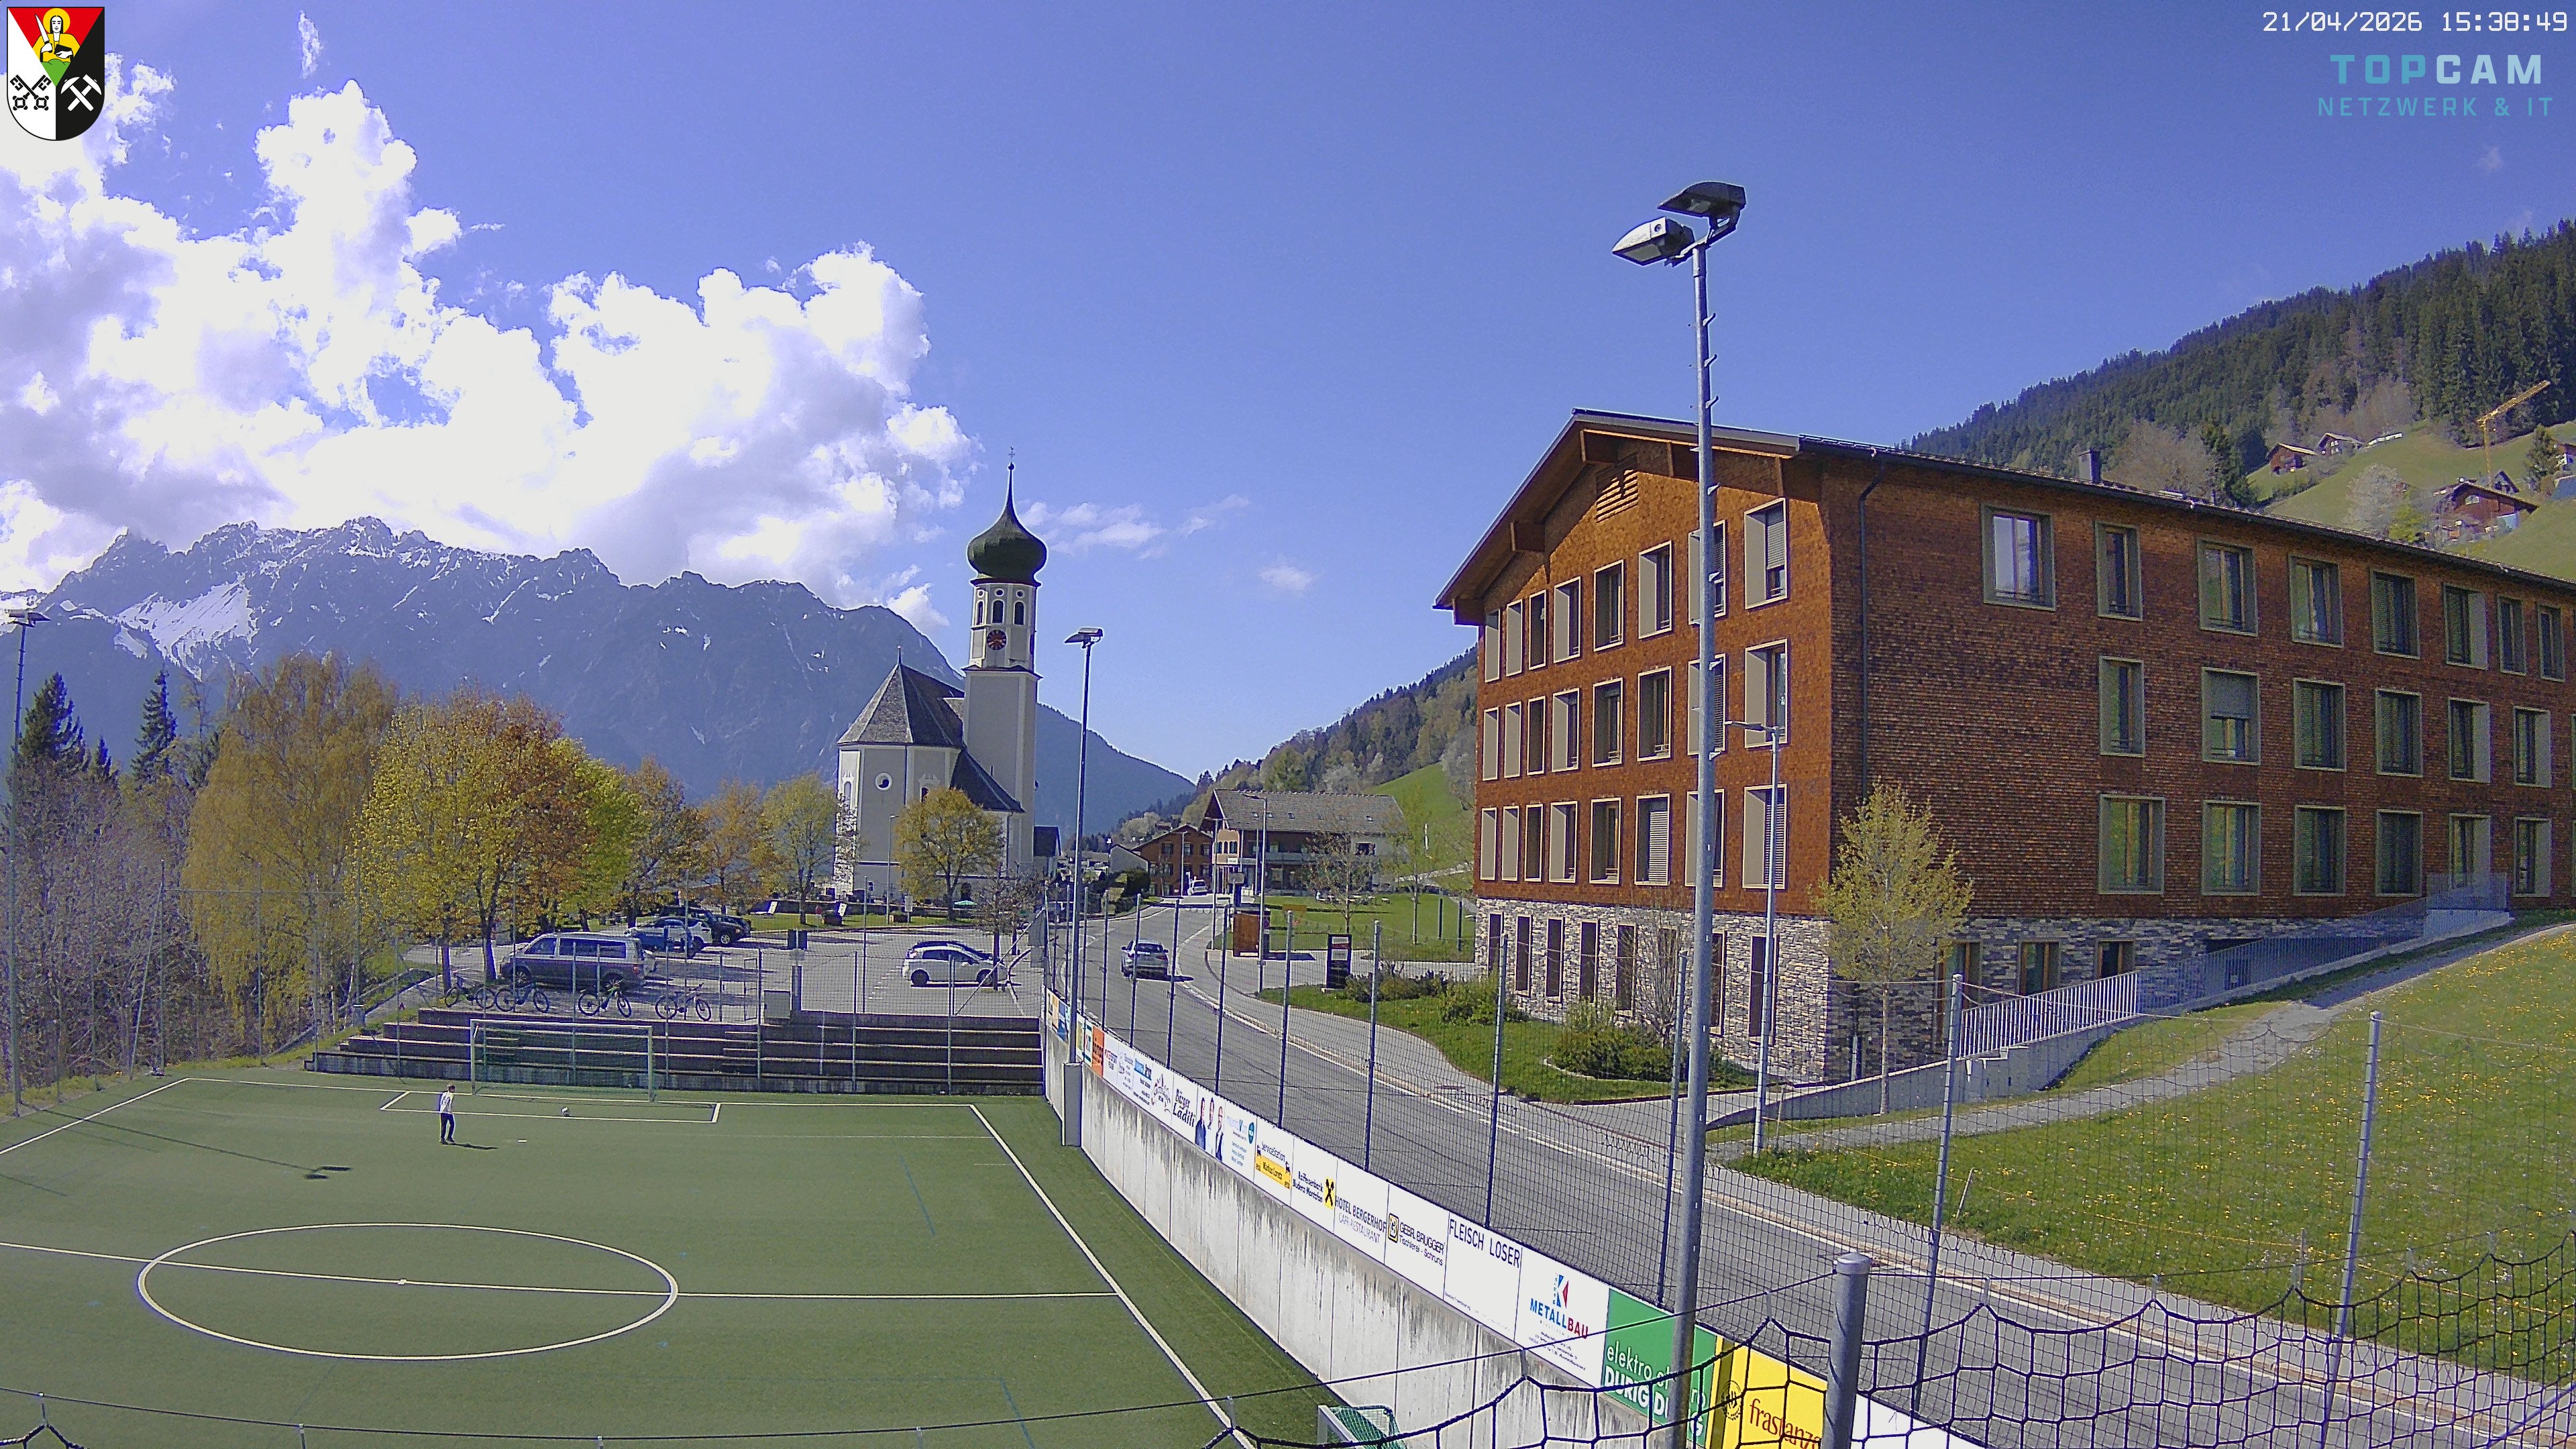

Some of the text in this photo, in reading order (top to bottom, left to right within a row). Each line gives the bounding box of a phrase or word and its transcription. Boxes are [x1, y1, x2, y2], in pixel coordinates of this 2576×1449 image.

[1335, 1195, 1387, 1233] HOTEL BERGERHOF
[1424, 1248, 1443, 1266] Schruns
[1449, 1218, 1521, 1269] FLEISCH LOSER
[1529, 1297, 1589, 1340] METALLBAU
[1607, 1340, 1652, 1380] elektro
